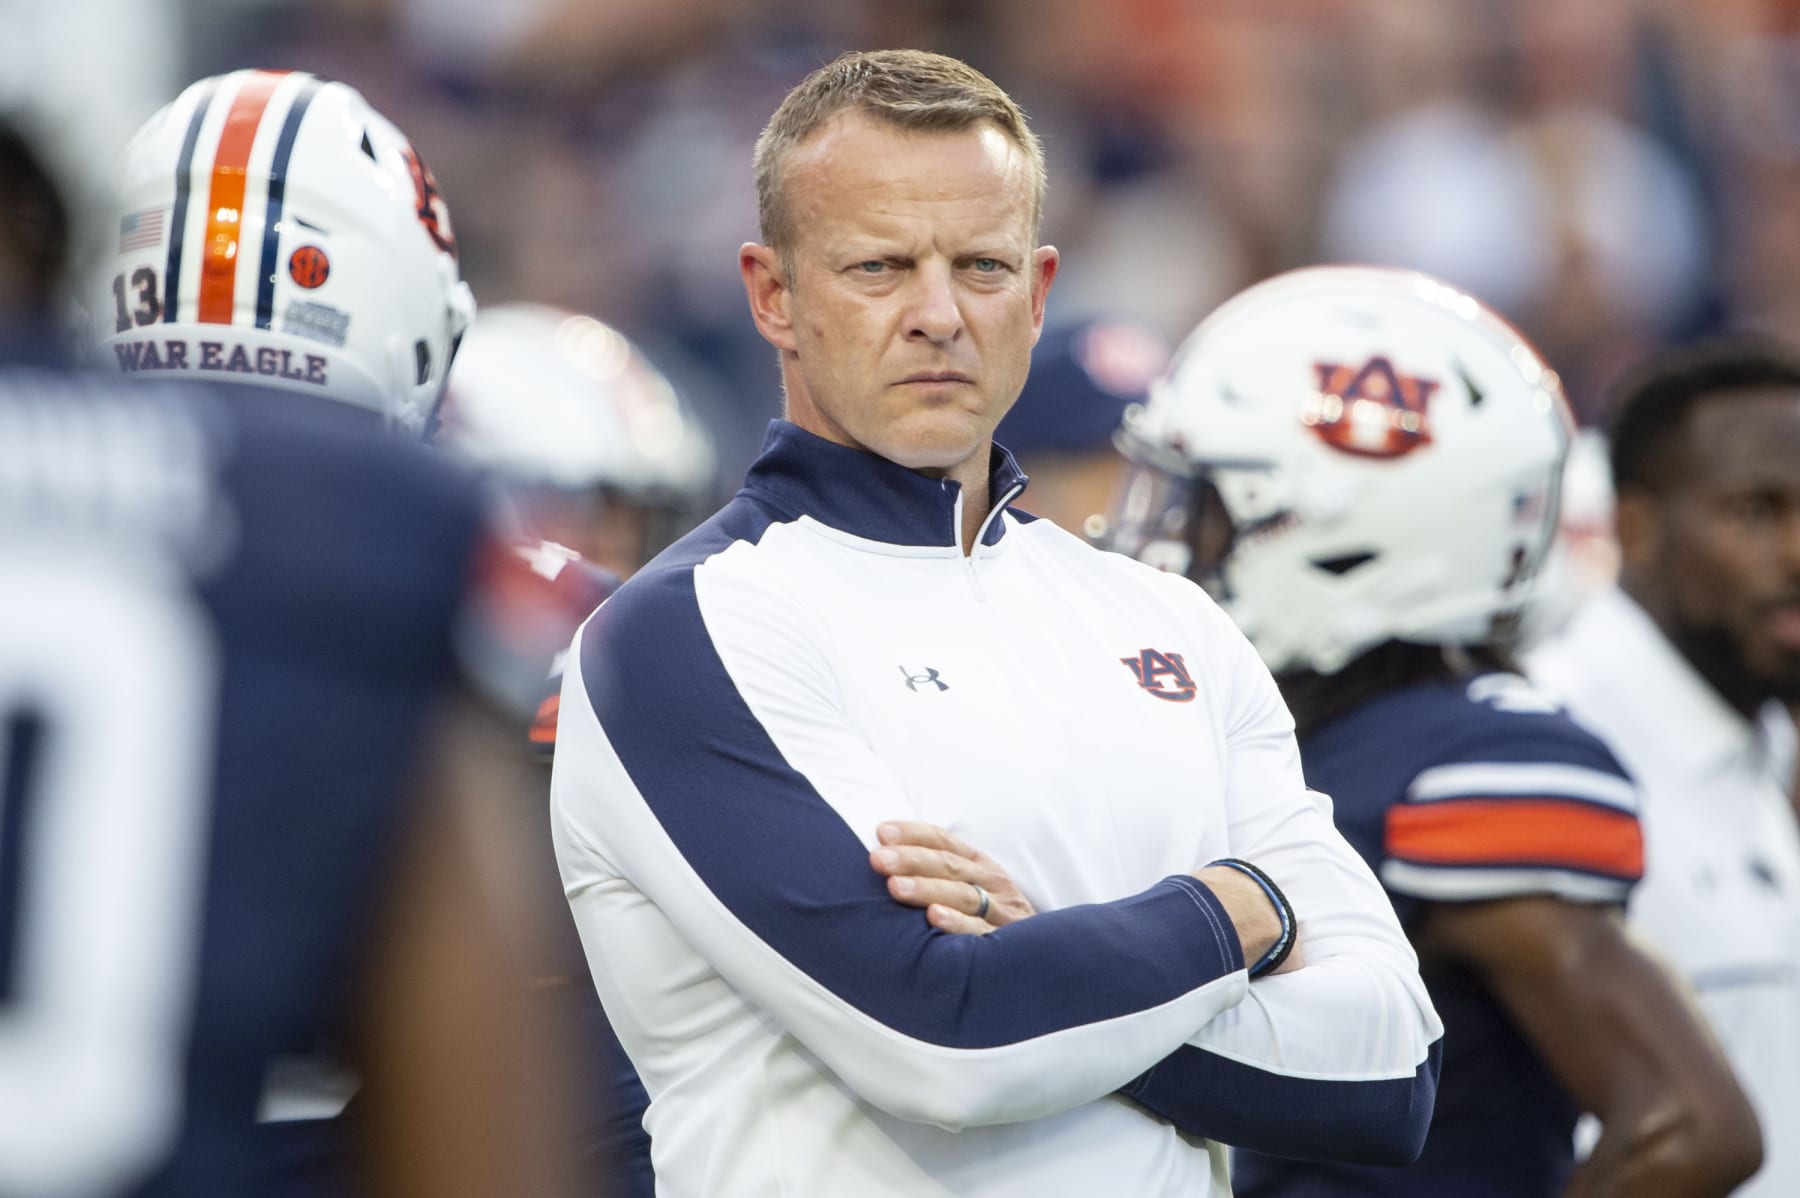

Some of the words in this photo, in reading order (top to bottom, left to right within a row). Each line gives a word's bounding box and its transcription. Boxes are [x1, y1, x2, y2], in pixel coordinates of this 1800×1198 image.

[112, 266, 162, 333] 13
[114, 341, 188, 372] WAR
[199, 342, 327, 385] EAGLE
